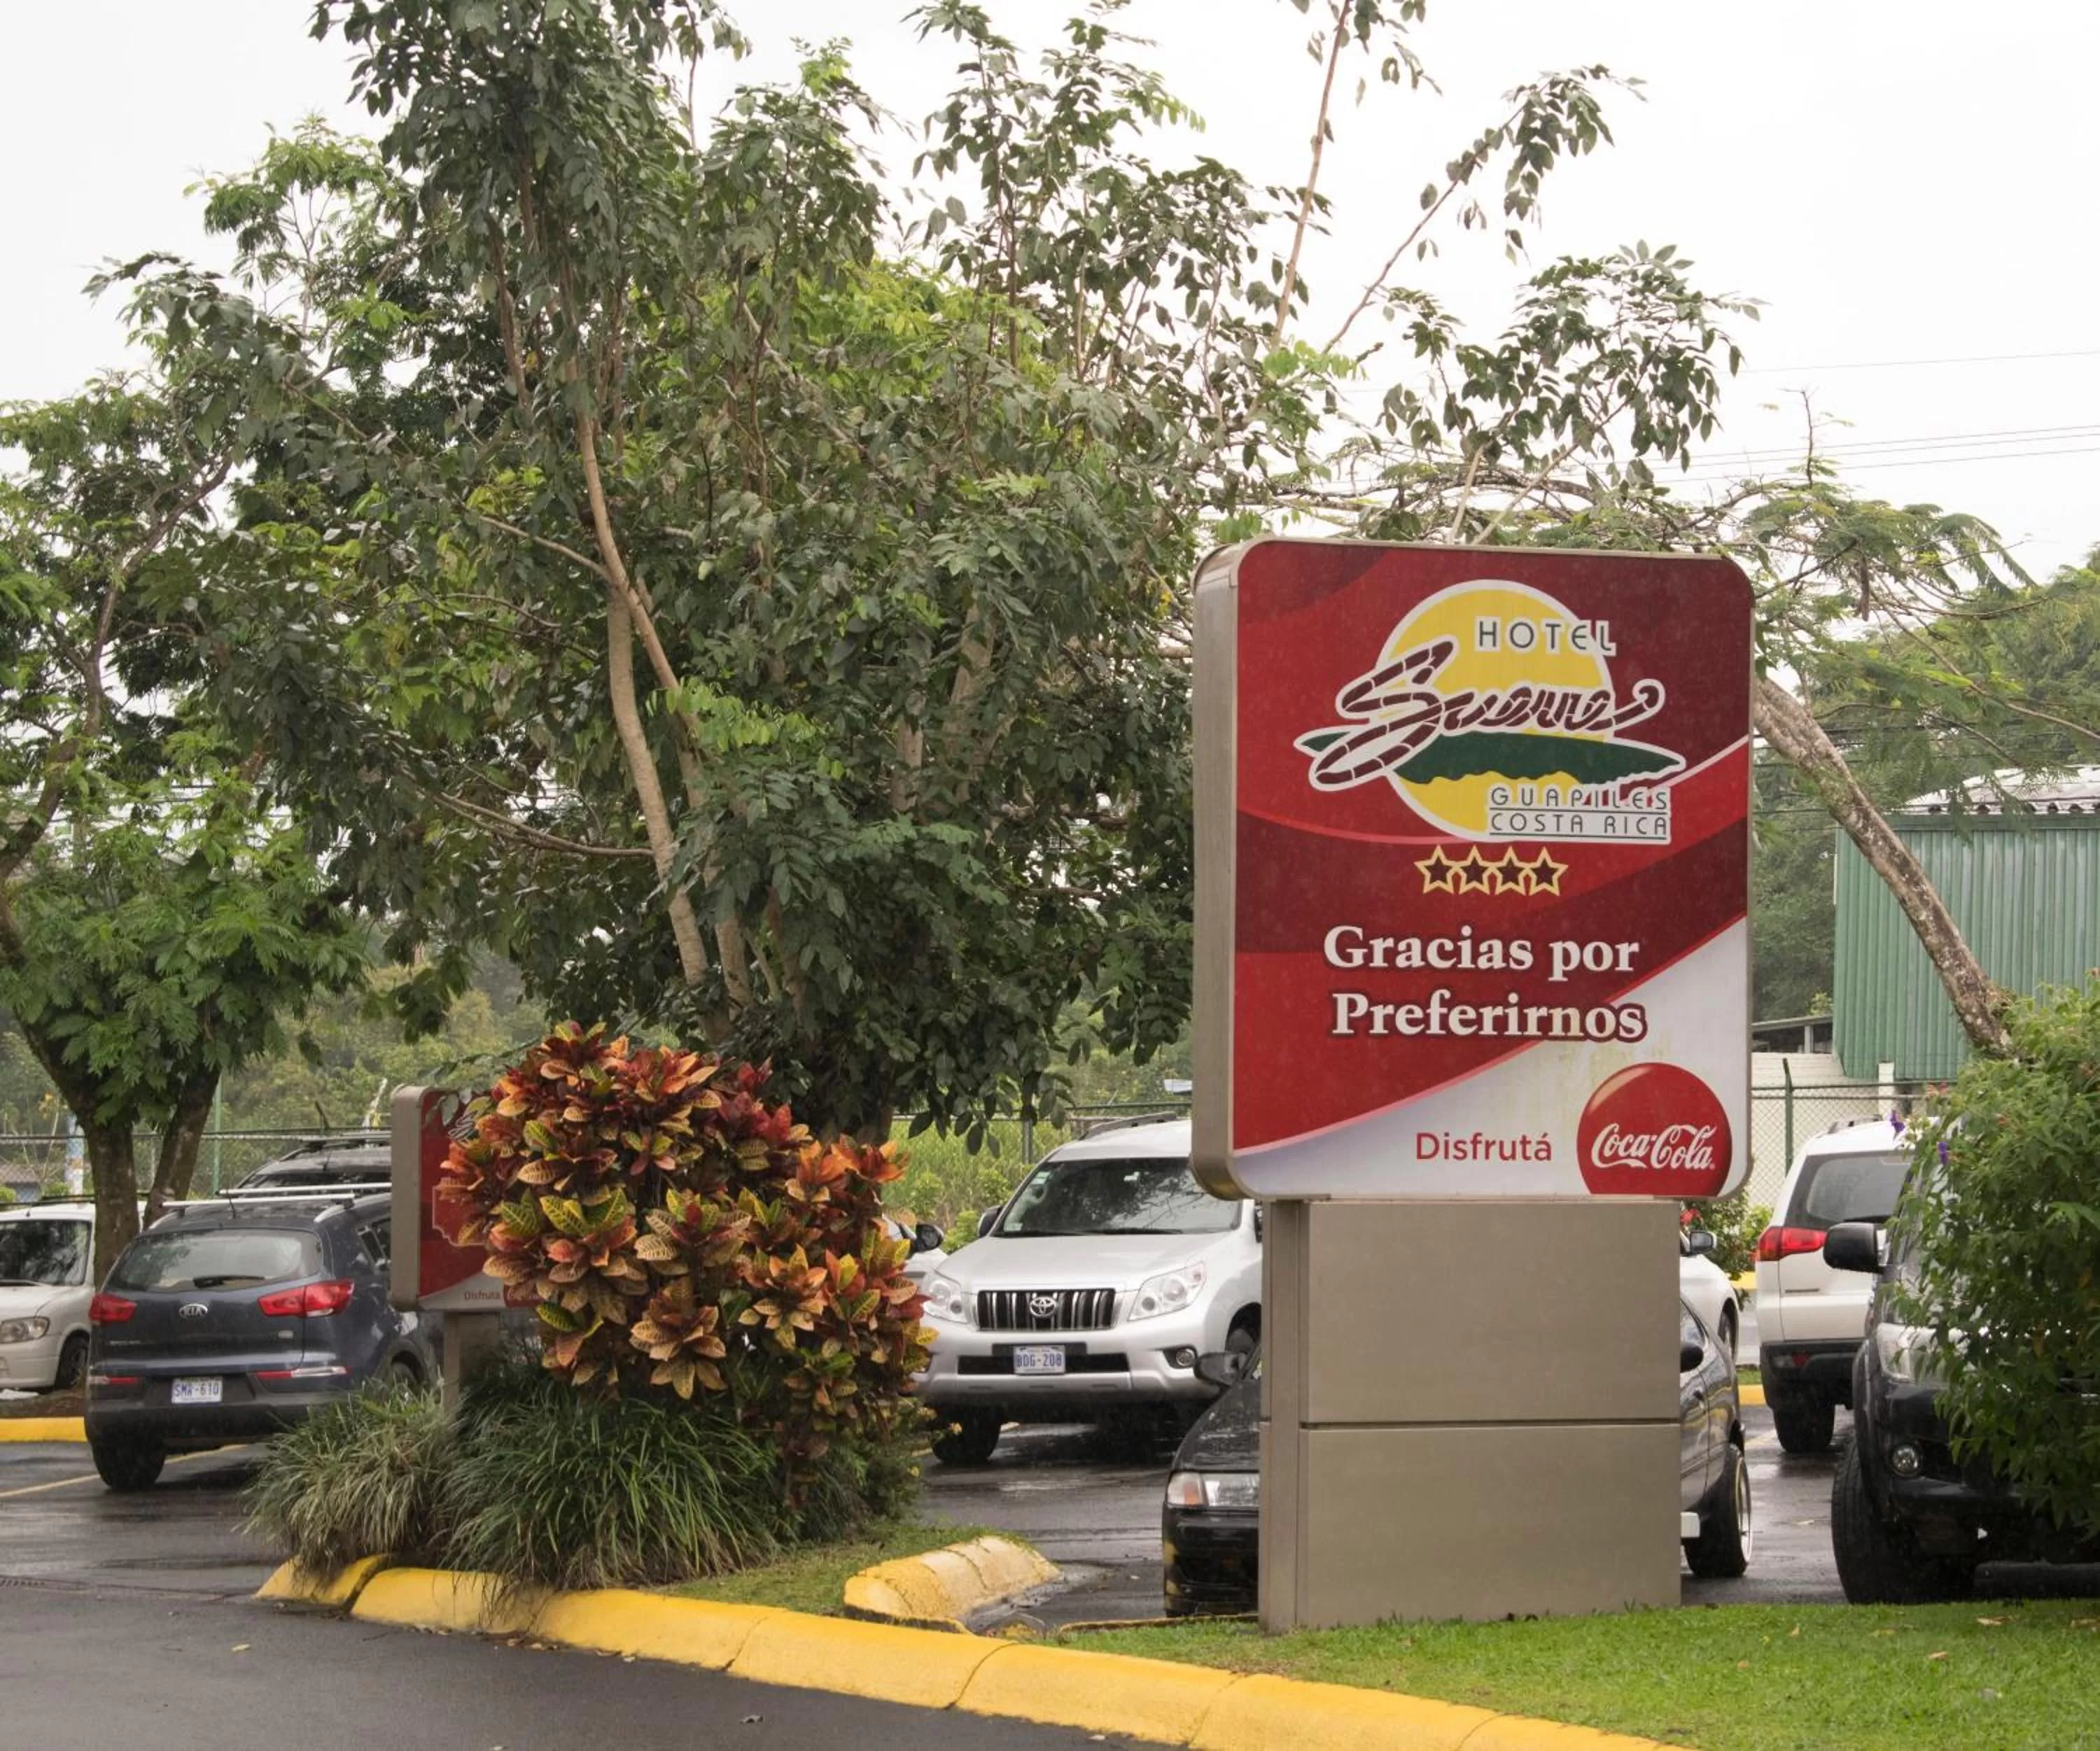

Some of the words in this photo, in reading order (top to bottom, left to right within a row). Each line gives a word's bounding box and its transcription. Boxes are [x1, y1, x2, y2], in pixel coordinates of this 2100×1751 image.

[1478, 621, 1614, 652] HOTEL
[1491, 787, 1667, 810] GUAPILES
[1491, 813, 1583, 833] COSTA
[1604, 815, 1667, 835] RICA
[1323, 925, 1534, 971] Gracias
[1548, 940, 1640, 981] por
[1331, 990, 1645, 1040] Preferirnos
[1415, 1132, 1553, 1161] Disfrutá
[1590, 1123, 1717, 1170] Coca-Cola
